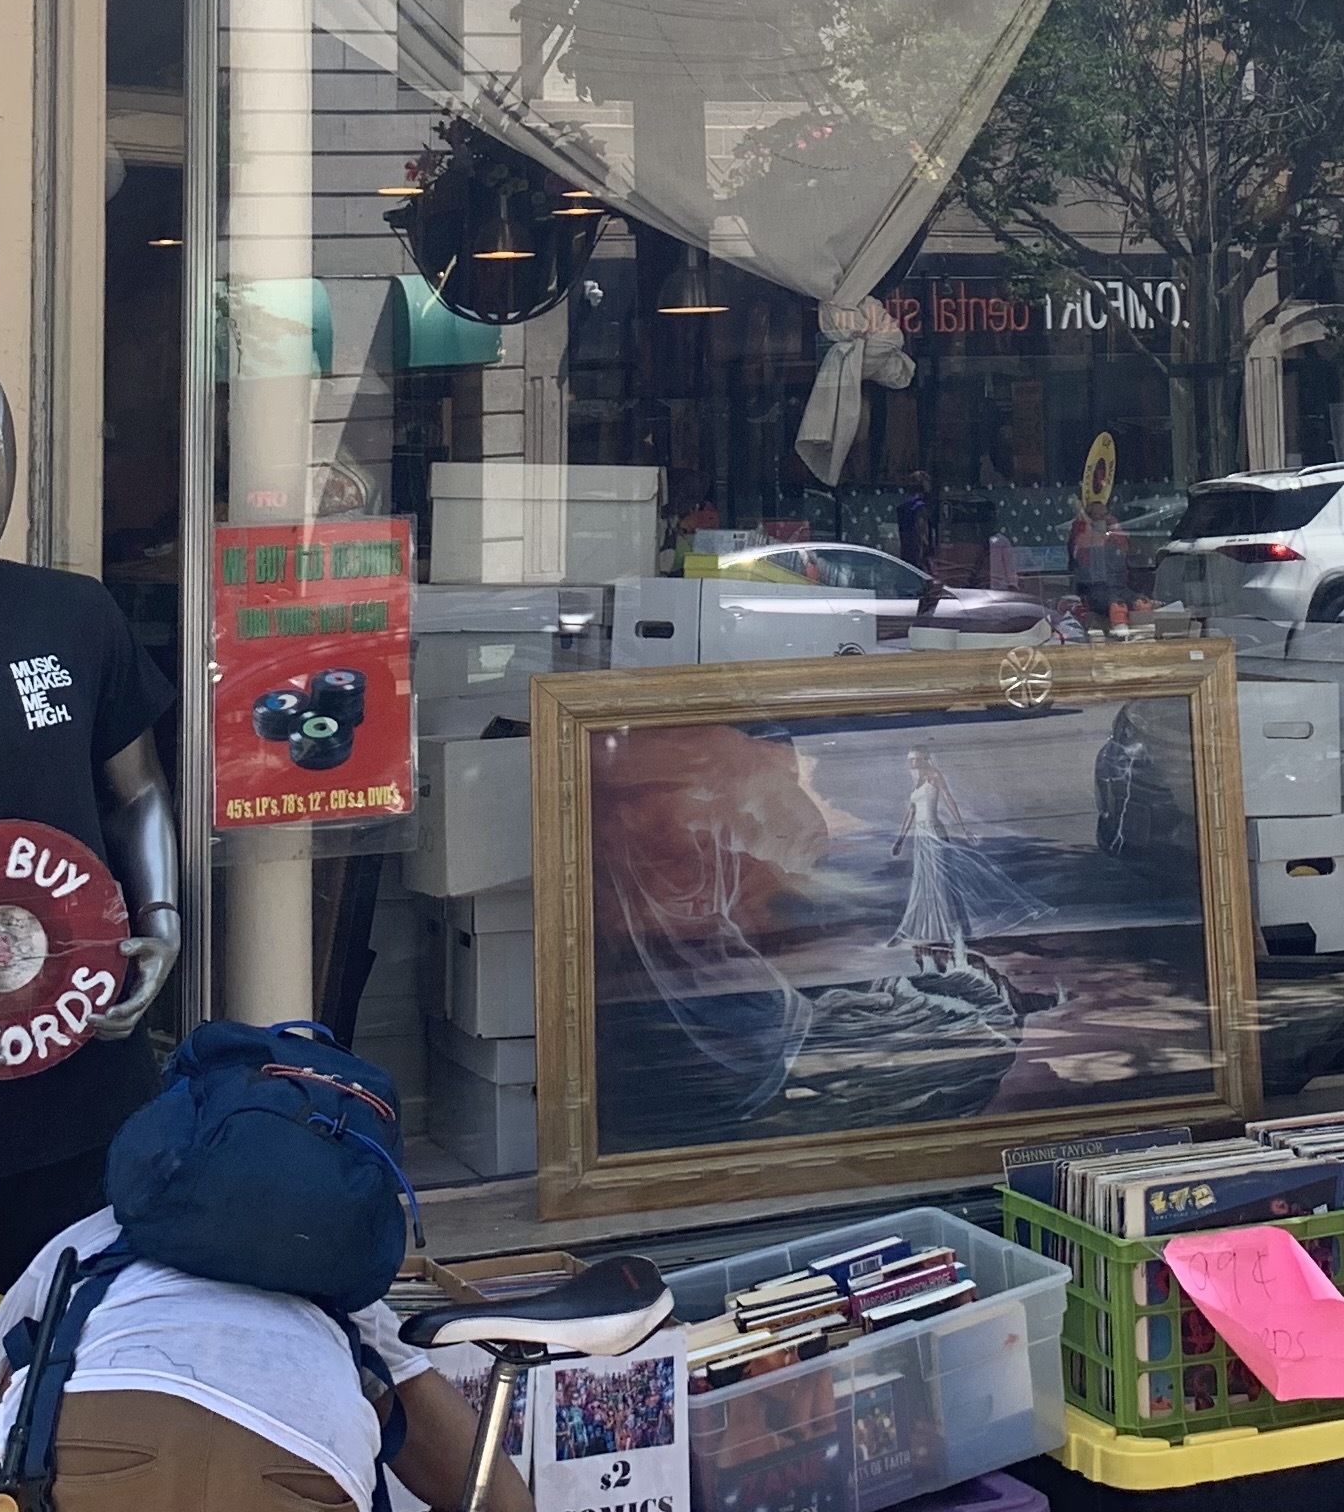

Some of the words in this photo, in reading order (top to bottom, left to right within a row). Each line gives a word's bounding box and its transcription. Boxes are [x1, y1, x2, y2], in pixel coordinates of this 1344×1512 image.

[9, 654, 61, 680] MUSIC
[15, 669, 73, 695] MAKES
[20, 691, 51, 713] ME
[26, 704, 73, 730] HIGH.
[5, 836, 91, 898] BUY
[1008, 1147, 1057, 1166] JOHNNIE
[1059, 1140, 1105, 1158] TAYLOR
